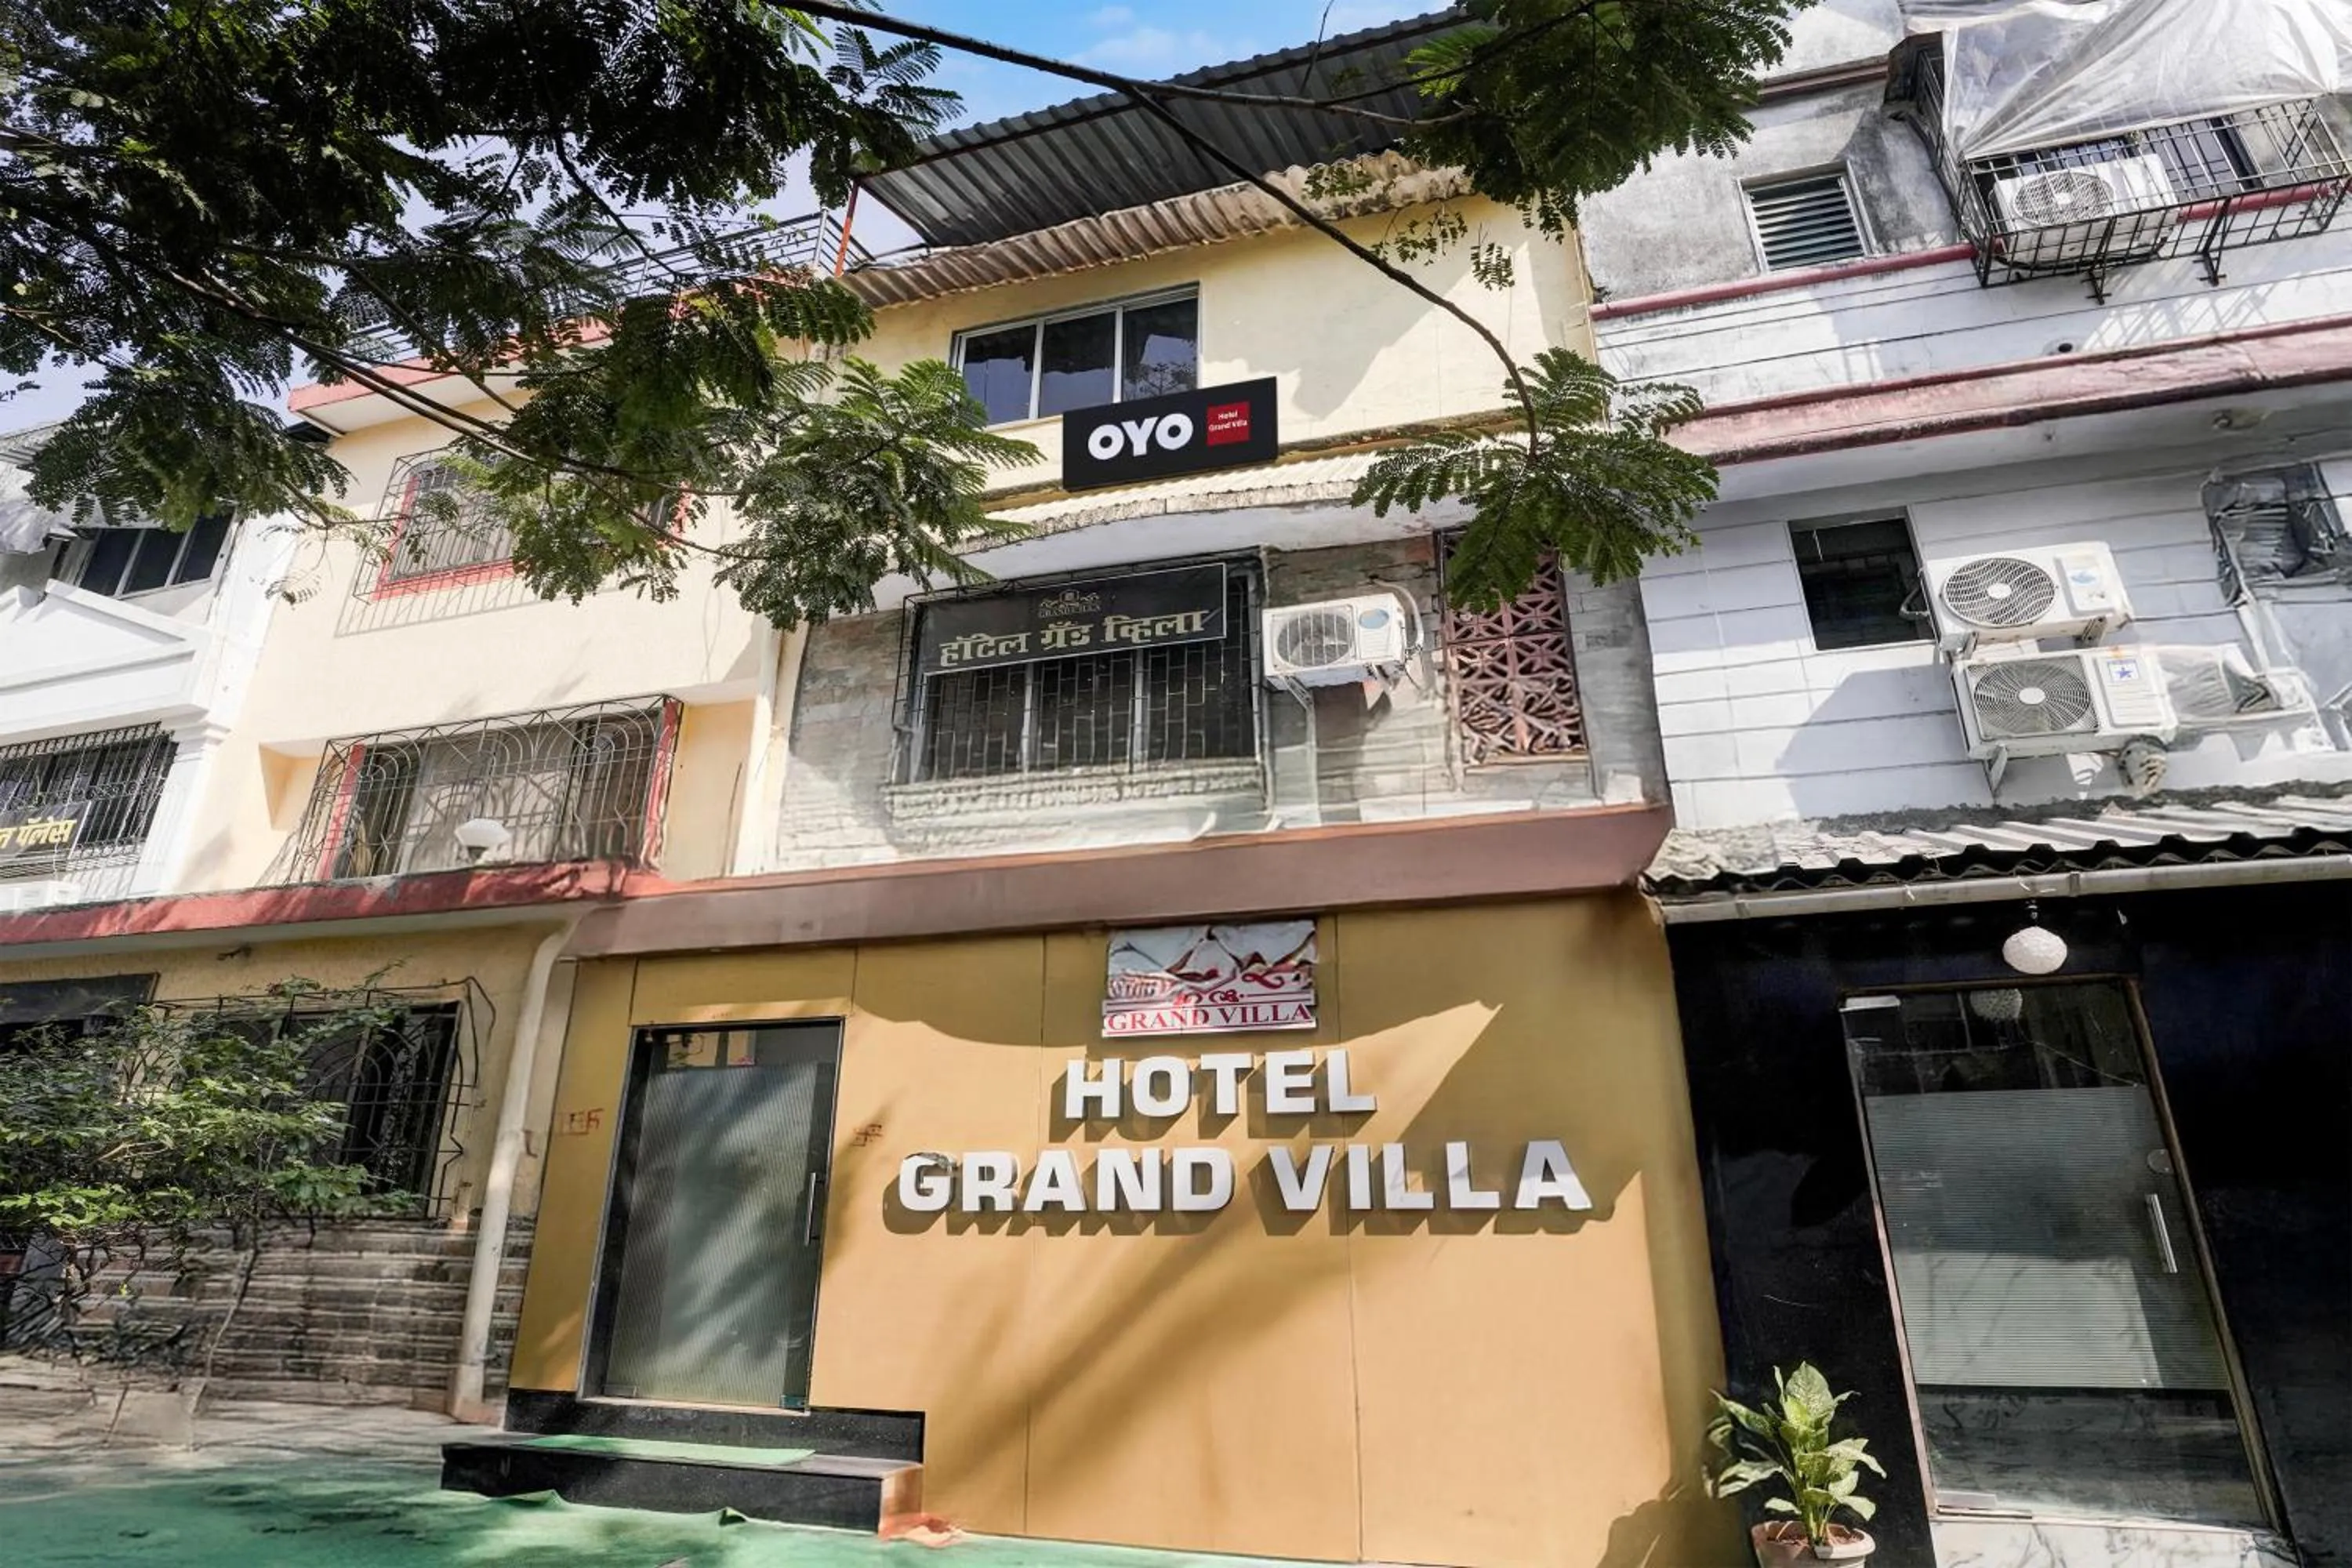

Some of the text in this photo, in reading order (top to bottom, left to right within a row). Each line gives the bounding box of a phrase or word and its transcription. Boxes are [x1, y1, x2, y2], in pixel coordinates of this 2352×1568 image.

[1087, 412, 1194, 461] OYO
[939, 632, 1032, 667] हॉटेल
[1108, 1003, 1311, 1030] GRAND VILLA
[1065, 1048, 1377, 1119] HOTEL
[898, 1141, 1592, 1212] GRAND VILLA
